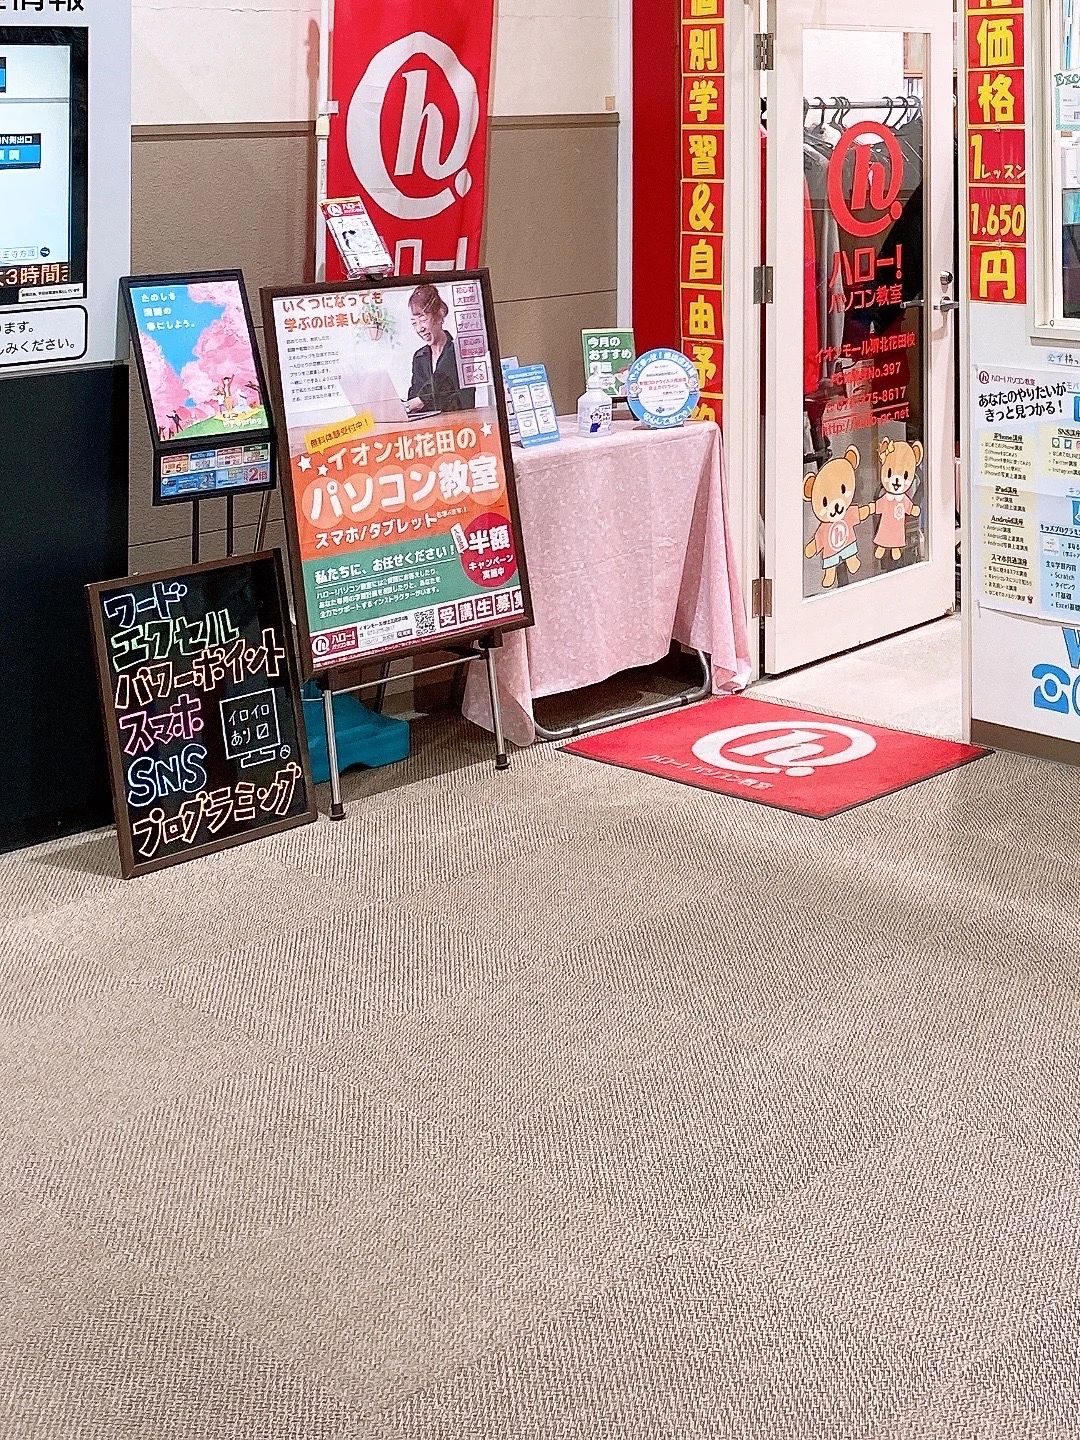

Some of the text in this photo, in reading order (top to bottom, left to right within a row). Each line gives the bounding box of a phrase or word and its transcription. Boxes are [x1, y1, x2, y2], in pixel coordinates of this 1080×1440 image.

[971, 203, 1024, 237] 1,650
[829, 244, 902, 288] ハロー!
[980, 250, 1015, 299] 円
[282, 292, 383, 312] いくつになっても
[829, 284, 902, 314] パソコン教室
[588, 337, 620, 348] 今月の
[589, 349, 632, 360] おすすめ
[815, 332, 915, 363] イオンモール堺北花田校
[979, 382, 1066, 408] あなたのやりたいが
[985, 400, 1063, 422] きっと見つかる!
[328, 428, 477, 470] イオン北花田の
[310, 455, 499, 520] パソコン教室
[469, 525, 510, 554] 半額
[469, 554, 513, 571] キャンペーン
[1054, 571, 1075, 580] Scratch
[1055, 581, 1075, 591] タイピング
[104, 582, 188, 627] ワード
[111, 609, 240, 672] エクセル
[114, 628, 285, 709] パワーポイント
[119, 694, 204, 756] スマホ
[228, 704, 270, 726] イロイロ
[128, 743, 208, 807] SNS
[133, 762, 301, 857] プログラミング
